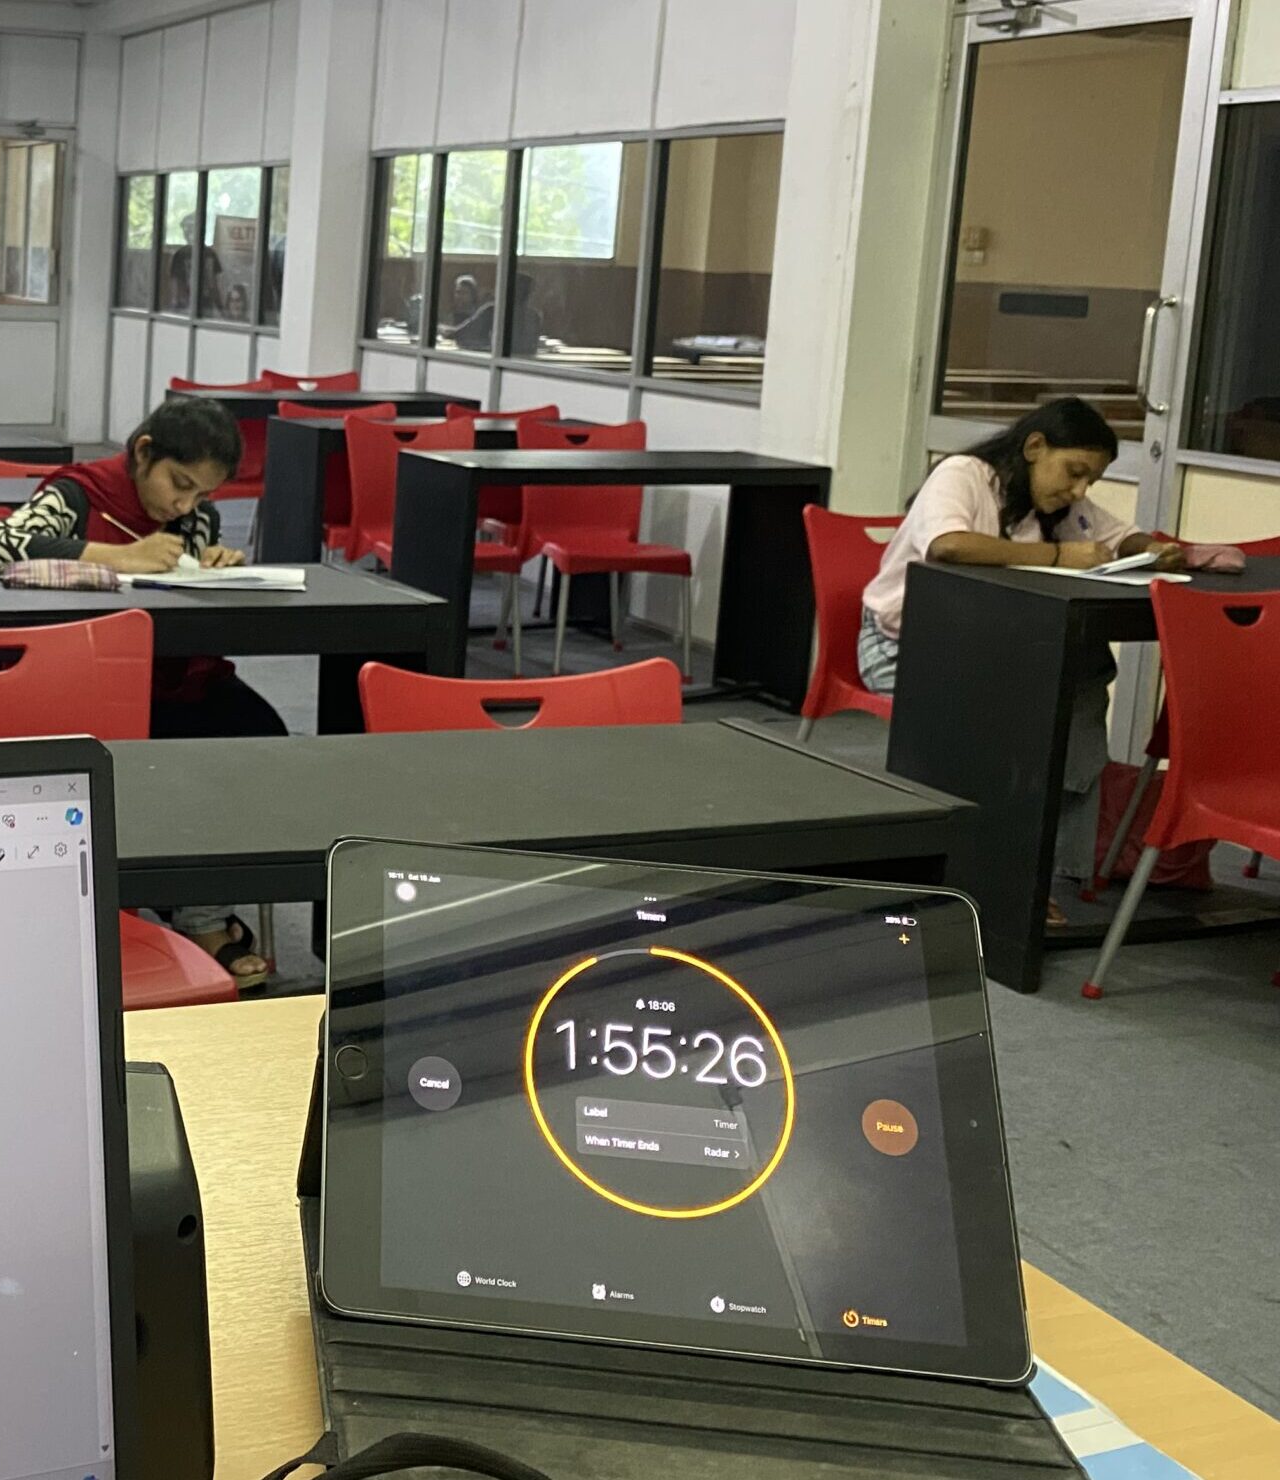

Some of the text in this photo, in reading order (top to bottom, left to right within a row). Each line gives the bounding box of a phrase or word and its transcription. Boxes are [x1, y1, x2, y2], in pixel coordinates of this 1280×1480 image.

[636, 910, 666, 922] Timers
[648, 1000, 676, 1012] 18:06
[555, 1019, 767, 1088] 1:55:26
[419, 1077, 450, 1090] Cancel
[584, 1106, 739, 1130] Label Timer
[876, 1121, 904, 1133] Pause
[585, 1135, 730, 1158] When Timer Ends Radar
[475, 1276, 517, 1288] World Clock
[609, 1290, 634, 1300] Alarms
[728, 1302, 767, 1314] Stopwatch
[861, 1316, 888, 1328] Timers
